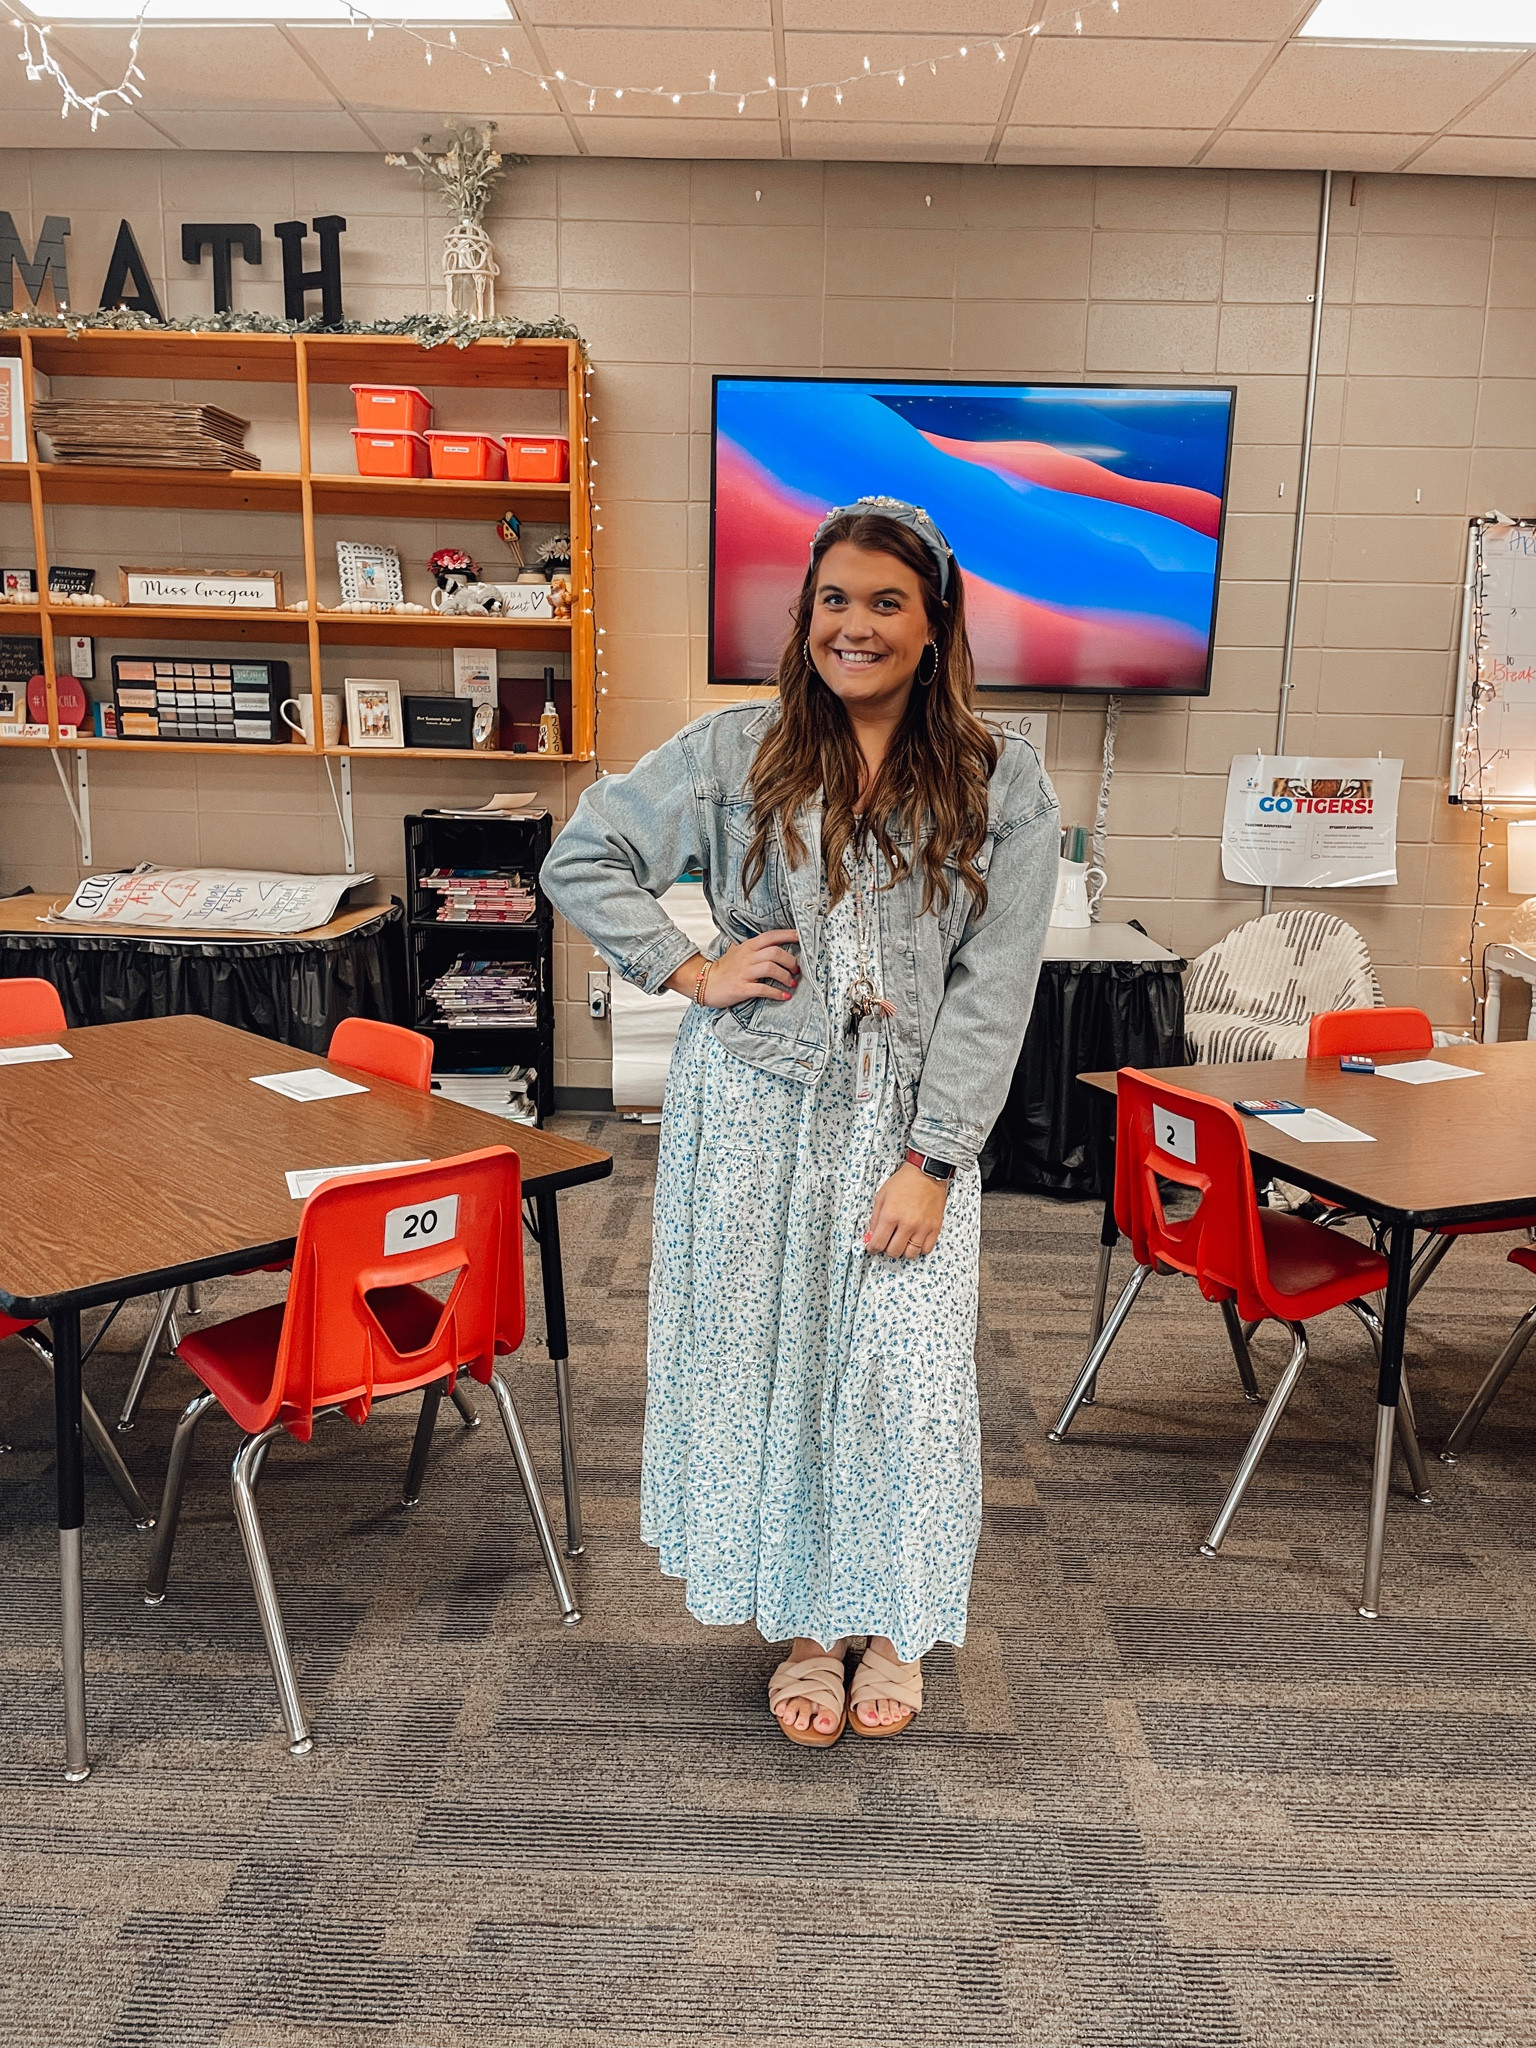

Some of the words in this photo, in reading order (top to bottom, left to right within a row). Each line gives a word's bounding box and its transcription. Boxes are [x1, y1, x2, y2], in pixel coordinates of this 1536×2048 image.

[0, 210, 347, 328] MATH
[50, 583, 87, 592] prayers
[140, 580, 190, 596] Miss
[195, 581, 263, 605] Grogan
[32, 695, 45, 707] #1
[552, 716, 560, 752] 2020
[1259, 796, 1293, 813] GO
[1294, 798, 1374, 814] TIGERS!
[1166, 1125, 1175, 1146] 2
[403, 1210, 438, 1239] 20
